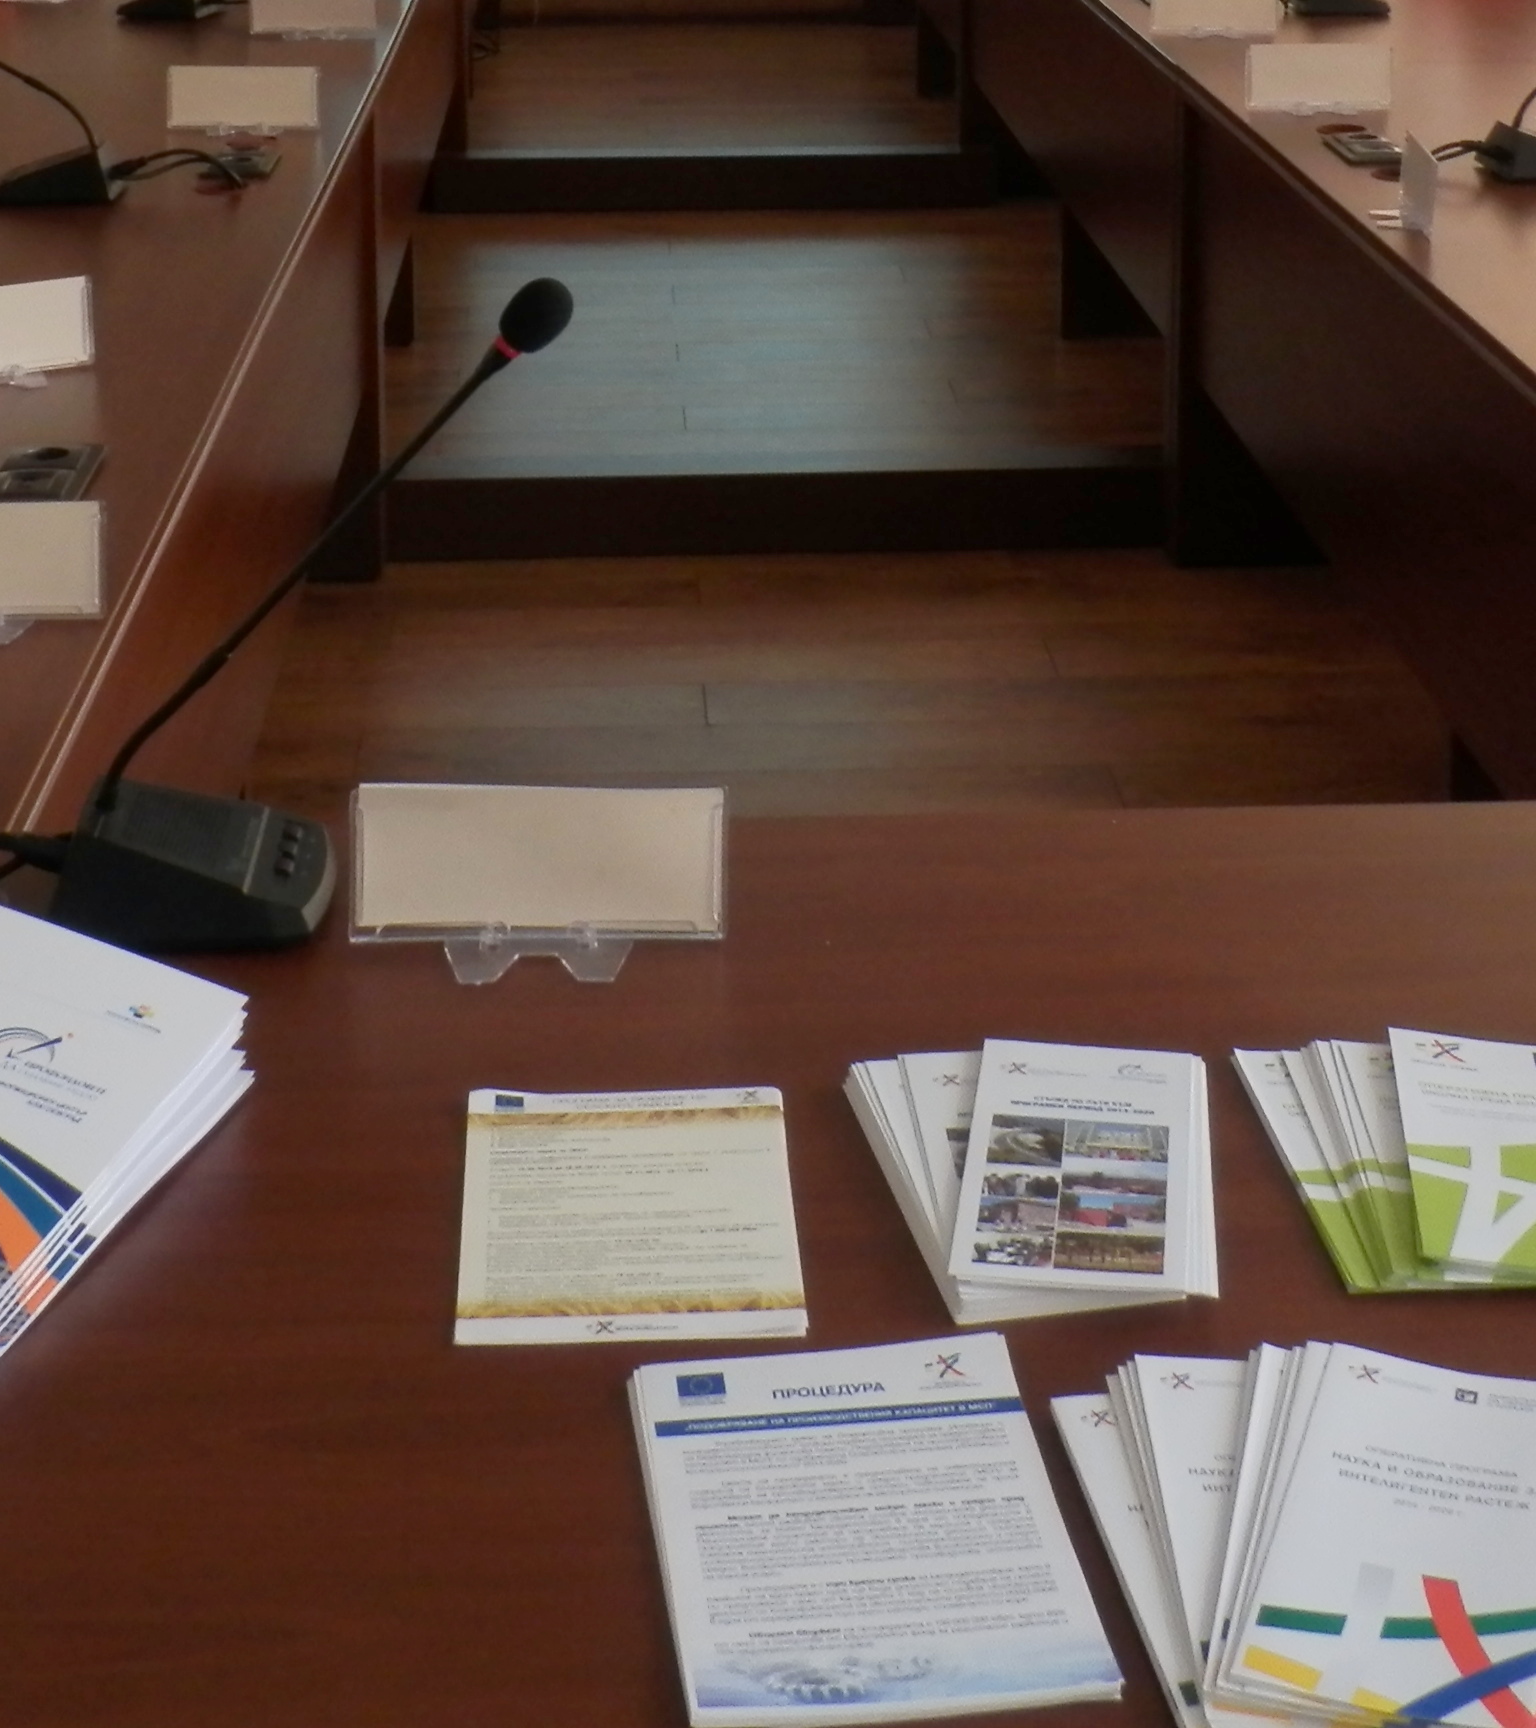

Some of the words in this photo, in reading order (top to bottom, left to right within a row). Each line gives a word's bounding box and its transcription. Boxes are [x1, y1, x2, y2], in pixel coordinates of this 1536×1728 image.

[772, 1382, 886, 1399] ПРОЦЕДУРА
[1332, 1451, 1381, 1470] НАУКА
[1387, 1464, 1398, 1473] И
[1404, 1468, 1519, 1494] ОБРАЗОВАНИЕ
[1465, 1494, 1530, 1510] РАСТЕЖ
